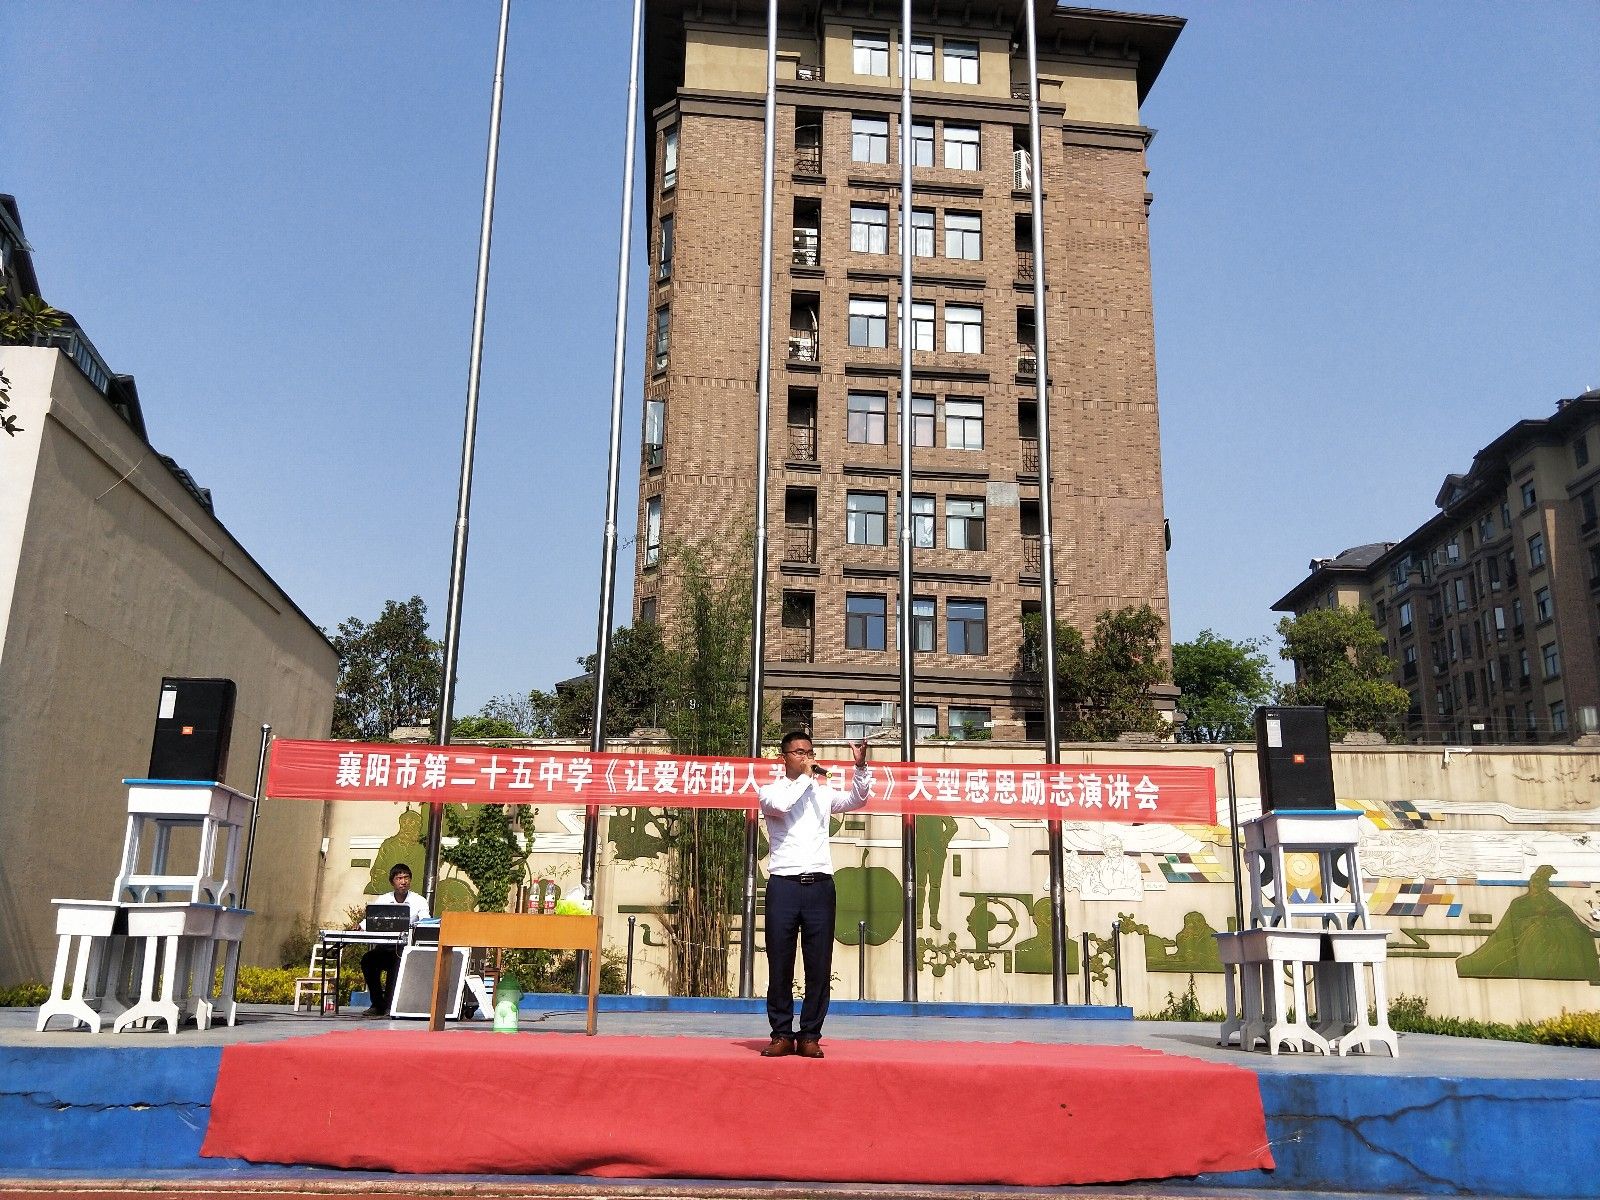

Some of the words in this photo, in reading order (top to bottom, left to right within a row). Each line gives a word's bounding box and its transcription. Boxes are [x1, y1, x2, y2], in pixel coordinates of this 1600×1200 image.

[336, 751, 1160, 810] 襄阳市第二十五中学《让爱你的人自》大型感恩励志演讲会
